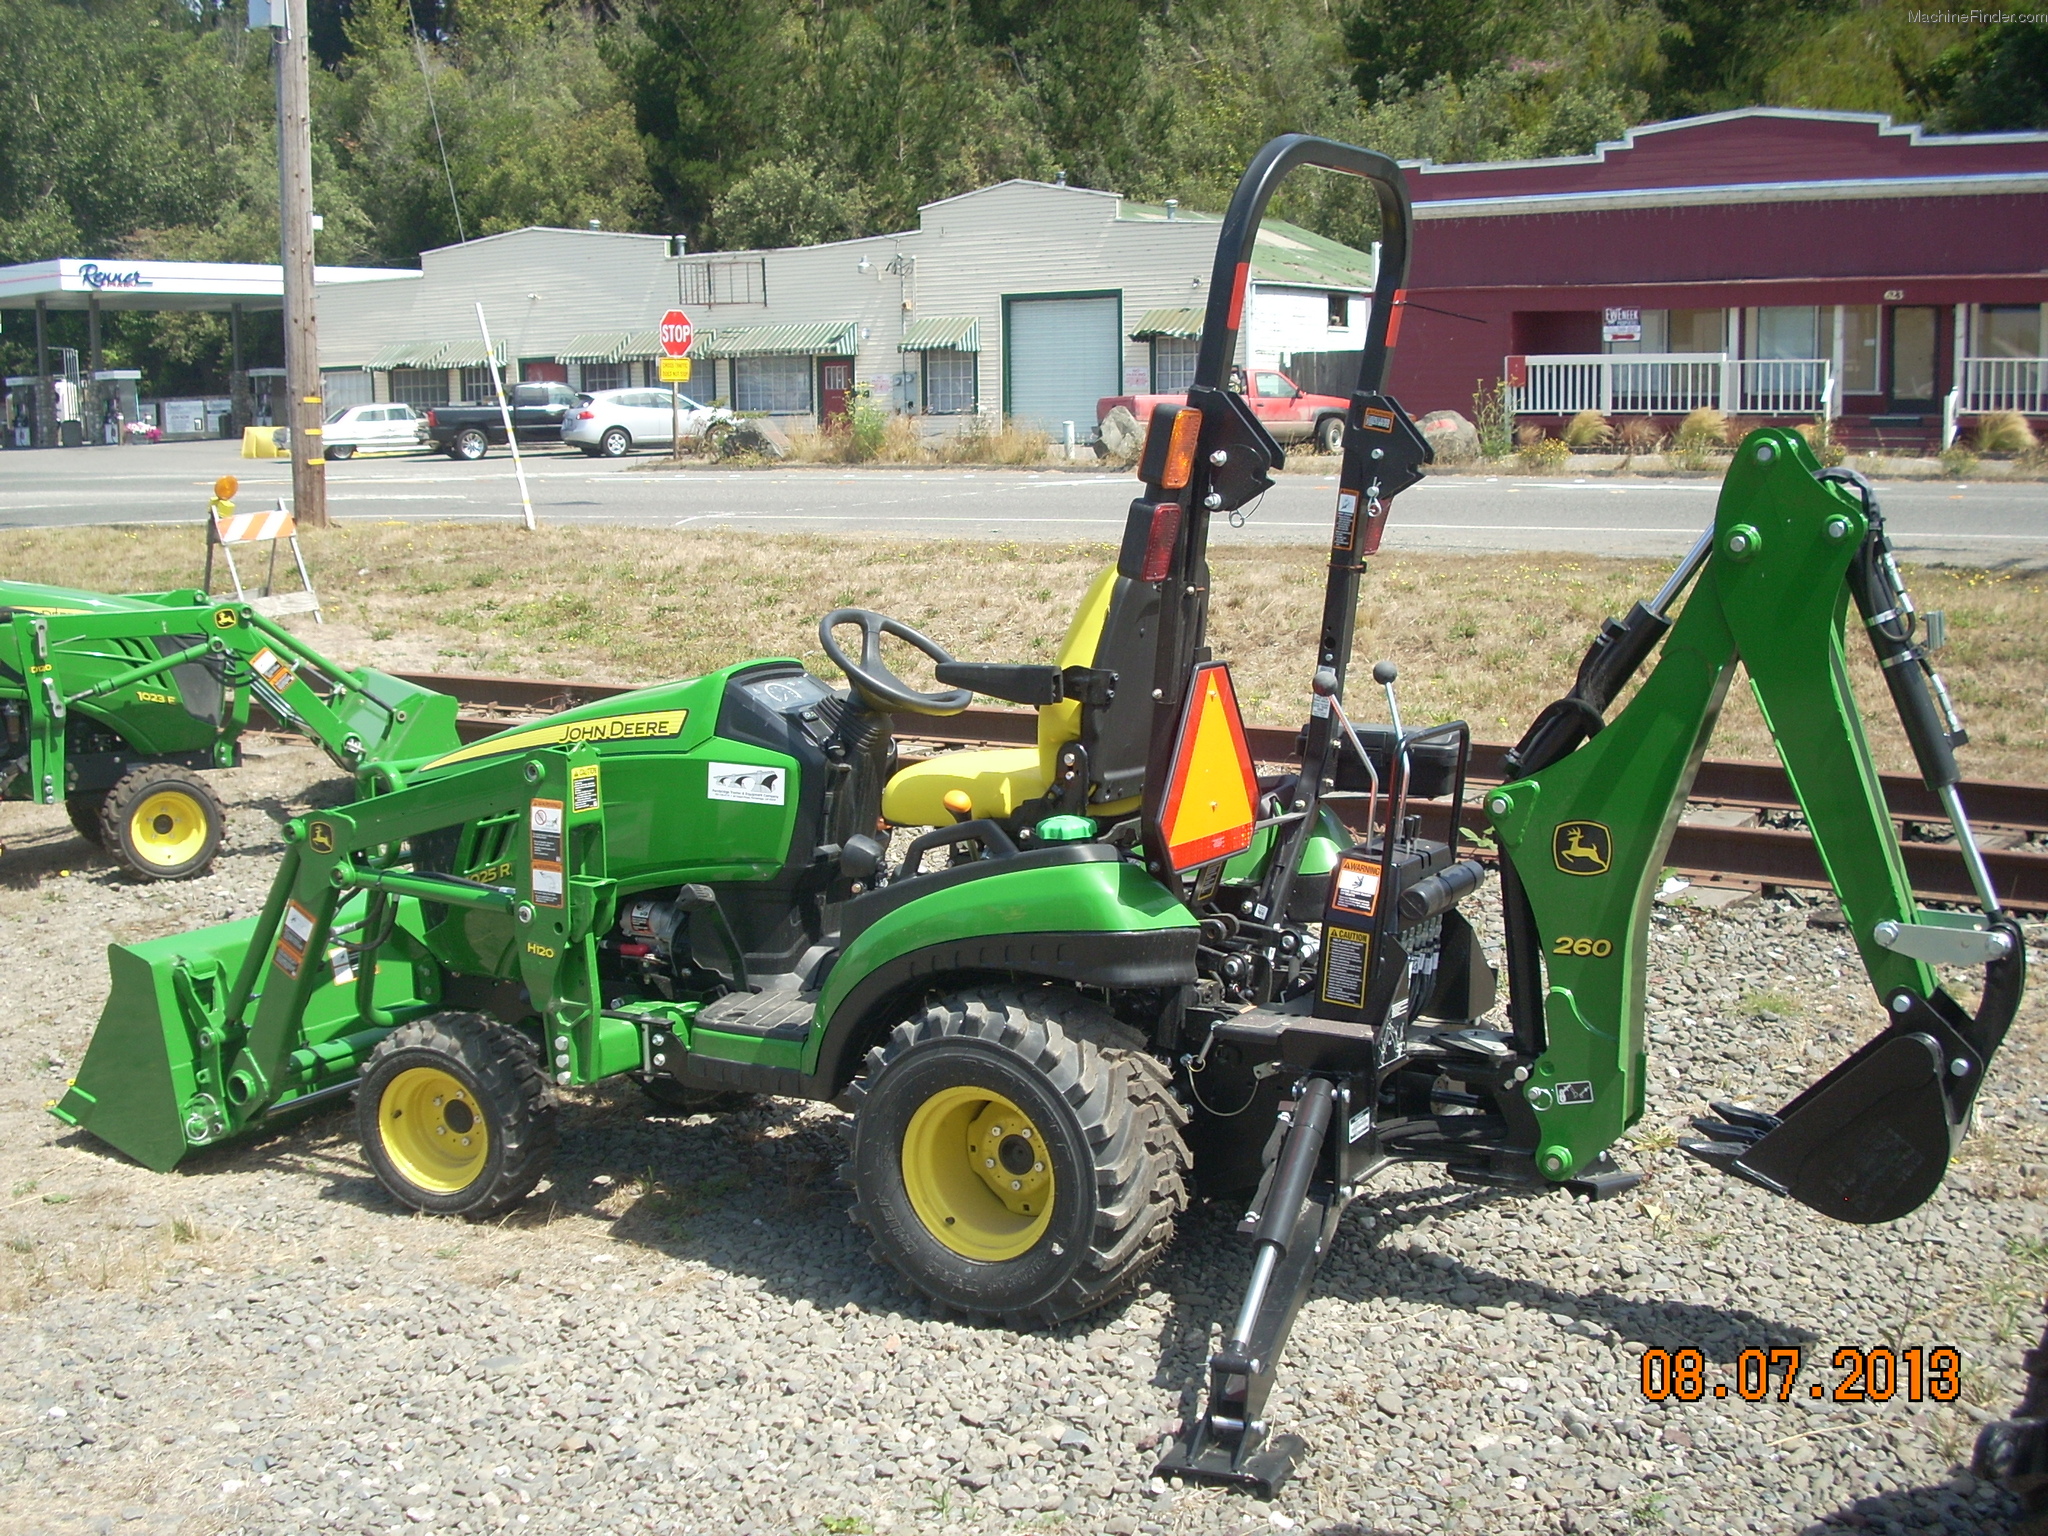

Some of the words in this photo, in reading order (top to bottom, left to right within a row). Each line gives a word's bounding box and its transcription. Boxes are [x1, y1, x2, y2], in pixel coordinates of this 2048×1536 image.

[79, 263, 153, 288] Renner
[662, 324, 691, 343] STOP
[136, 691, 165, 704] 1023
[558, 725, 606, 742] JOHN
[610, 721, 669, 738] DEERE
[465, 867, 497, 883] 025
[1350, 863, 1381, 876] WARNING
[1338, 929, 1368, 943] CAUTION
[527, 942, 555, 958] H120
[1553, 936, 1613, 958] 260
